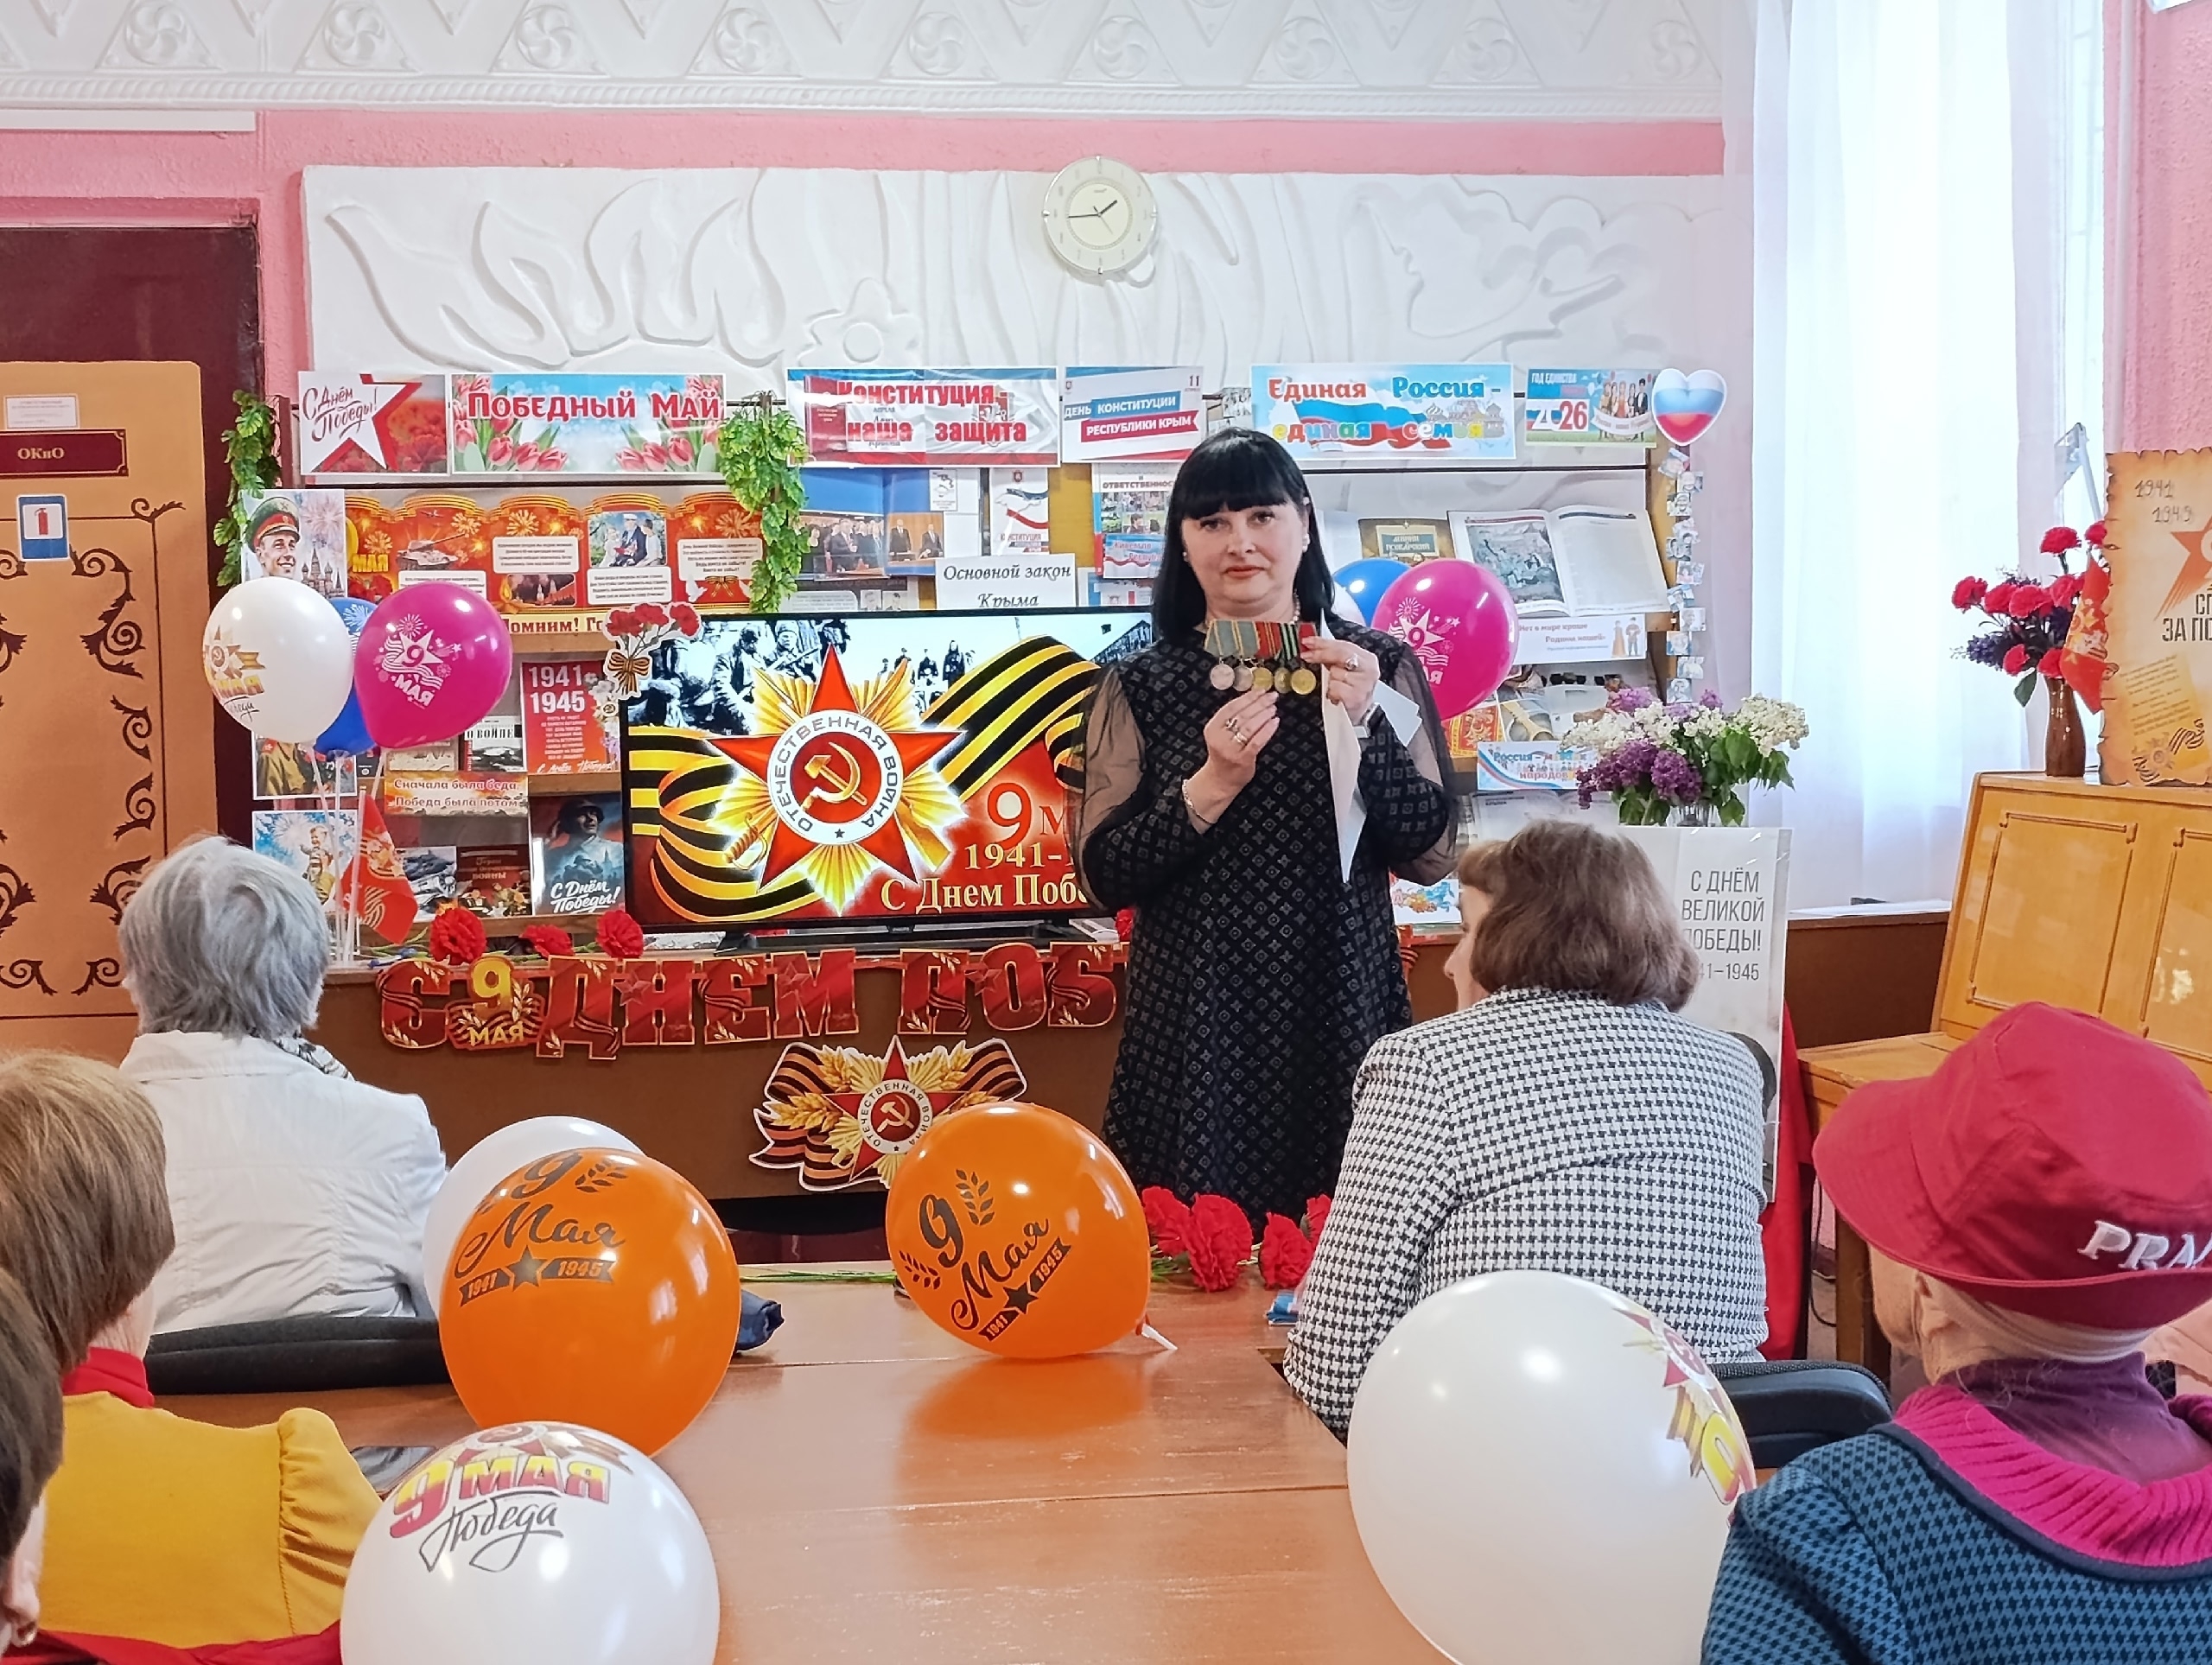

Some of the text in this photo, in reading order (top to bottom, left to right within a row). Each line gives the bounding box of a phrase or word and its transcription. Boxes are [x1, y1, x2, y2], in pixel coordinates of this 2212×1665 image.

[1189, 375, 1200, 387] 11
[1268, 378, 1367, 401] Единая
[1392, 377, 1485, 398] Россия
[1064, 396, 1176, 419] ДЕНЬ КОНСТИТУЦИИ
[847, 422, 1027, 443] наша защита
[1086, 416, 1192, 436] РЕСПУБЛИКИ КРЫМ
[1272, 422, 1484, 443] единая семья
[2134, 480, 2174, 499] 1941
[352, 554, 389, 572] МАЯ
[944, 564, 1071, 581] Основной закон
[977, 593, 1039, 608] Крыма
[2162, 617, 2187, 642] ЗА
[402, 645, 425, 667] 9
[529, 665, 582, 688] 1941
[394, 674, 435, 707] МАЯ
[530, 690, 585, 714] 1945
[1493, 752, 1533, 762] Россия
[394, 779, 448, 790] Сначала
[452, 779, 485, 790] была
[774, 716, 887, 832] ОТЕЧЕСТВЕННАЯ
[396, 797, 518, 808] Победа была потом
[987, 782, 1033, 851] 9
[964, 842, 1074, 870] 1941-
[550, 880, 612, 899] С Днём
[1691, 867, 1759, 894] С ДНЁМ
[550, 886, 622, 914] Победы!
[881, 877, 906, 911] С
[915, 876, 1004, 915] Днем
[1682, 896, 1765, 922] ВЕЛИКОЙ
[378, 941, 1129, 1060] С ДНЕМ ПОБ
[471, 958, 512, 1023] 9
[468, 1023, 524, 1046] МАЯ
[861, 1082, 924, 1147] ОТЕЧЕСТВЕННАЯ
[512, 1153, 582, 1199] 9
[454, 1201, 626, 1280] Мая
[918, 1194, 964, 1268] 9
[950, 1218, 1050, 1331] Мая
[1035, 1246, 1063, 1283] 1945
[467, 1261, 602, 1299] 1941 1945
[390, 1455, 611, 1539] 9 МАЯ
[419, 1489, 565, 1573] Победа
